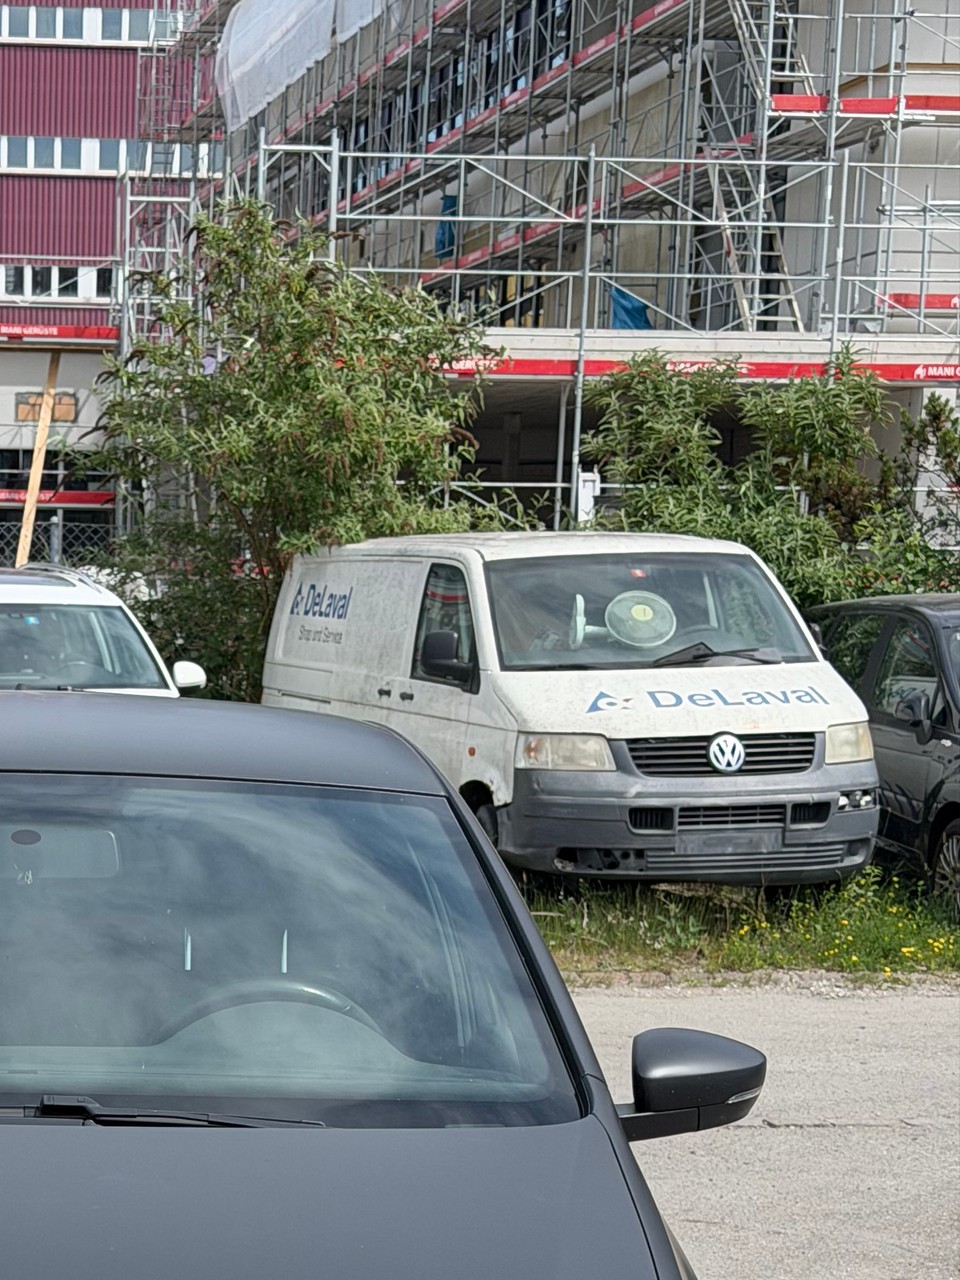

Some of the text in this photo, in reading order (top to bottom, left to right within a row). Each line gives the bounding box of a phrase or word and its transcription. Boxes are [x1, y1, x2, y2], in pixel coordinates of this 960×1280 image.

[927, 366, 955, 377] MANI
[303, 583, 353, 620] DeLaval
[646, 686, 831, 709] DeLaval
